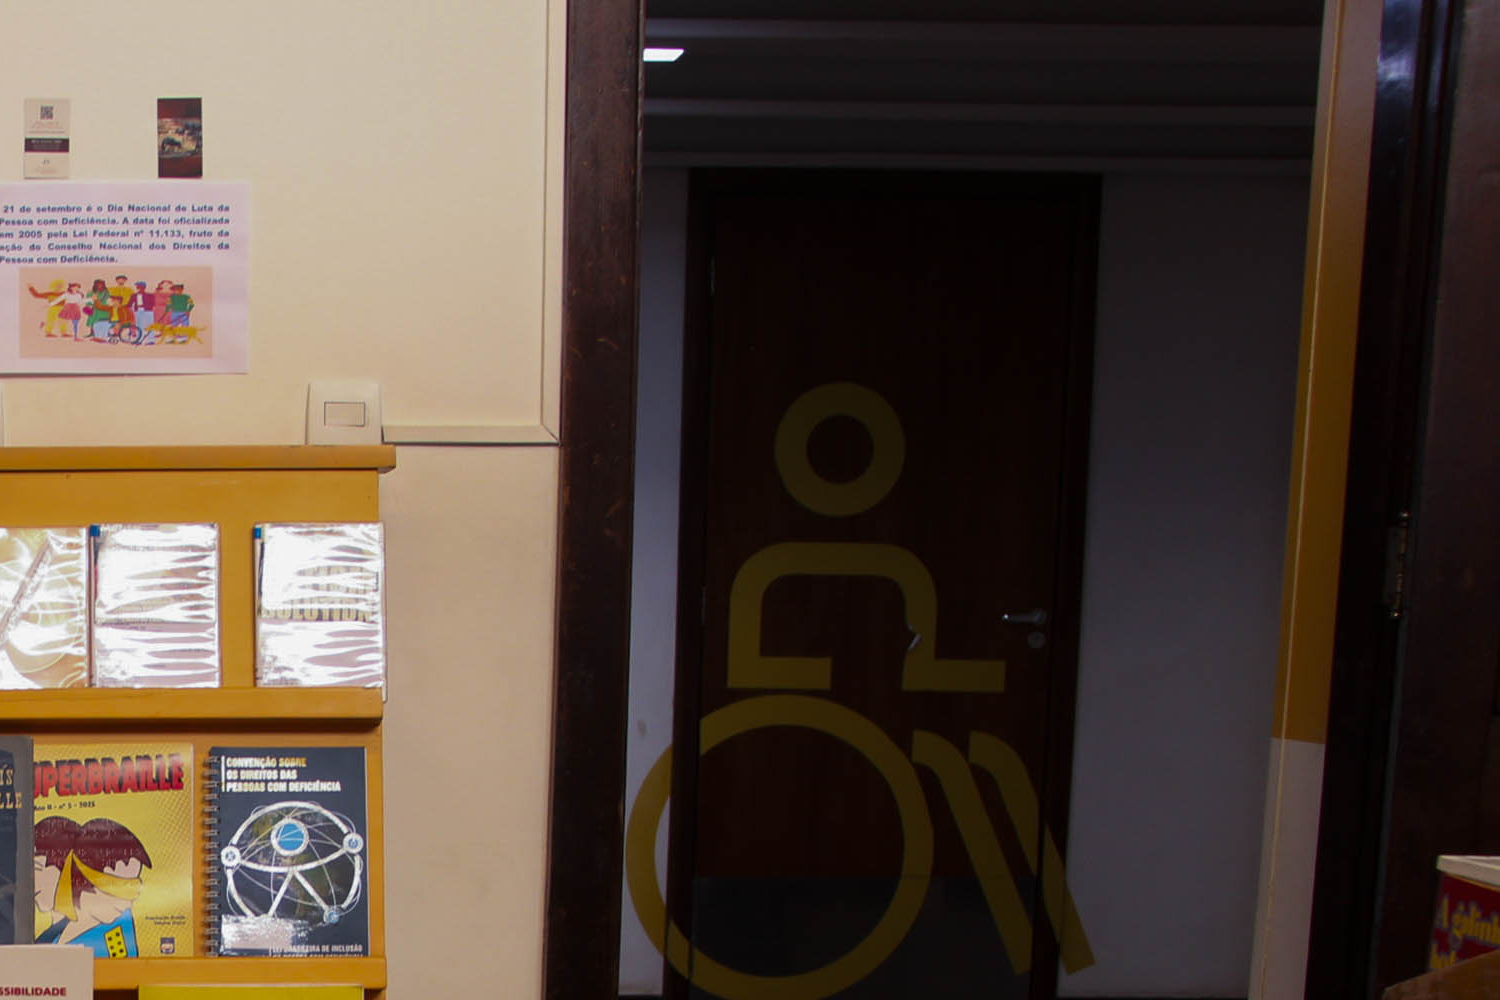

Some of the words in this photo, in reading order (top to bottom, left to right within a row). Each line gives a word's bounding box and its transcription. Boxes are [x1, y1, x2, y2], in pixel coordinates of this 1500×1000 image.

[3, 204, 14, 213] 21
[19, 204, 32, 213] de
[36, 204, 82, 213] setembro
[107, 203, 124, 212] Dia
[128, 203, 171, 212] Nacional
[191, 203, 214, 212] Luta
[217, 204, 230, 212] da
[37, 218, 58, 226] com
[61, 216, 119, 226] Deficiência.
[122, 217, 129, 225] A
[132, 216, 155, 225] data
[158, 216, 171, 225] foi
[173, 216, 230, 225] oficializada
[18, 230, 42, 239] 2005
[47, 230, 68, 240] pela
[72, 229, 88, 238] Lei
[92, 229, 129, 238] Federal
[189, 229, 213, 238] fruto
[217, 229, 230, 238] da
[47, 242, 93, 251] Conselho
[99, 242, 142, 251] Nacional
[148, 242, 167, 251] dos
[172, 242, 212, 251] Direitos
[217, 242, 230, 251] da
[36, 256, 58, 264] com
[60, 254, 118, 264] Deficiência.
[226, 756, 278, 769] CONVENÇÃO
[278, 757, 307, 768] SOBRE
[226, 769, 239, 780] OS
[240, 769, 279, 780] DIREITOS
[280, 769, 298, 780] DAS
[226, 781, 266, 793] PESSOAS
[267, 781, 288, 793] COM
[288, 779, 342, 793] DEFICIÊNCIA
